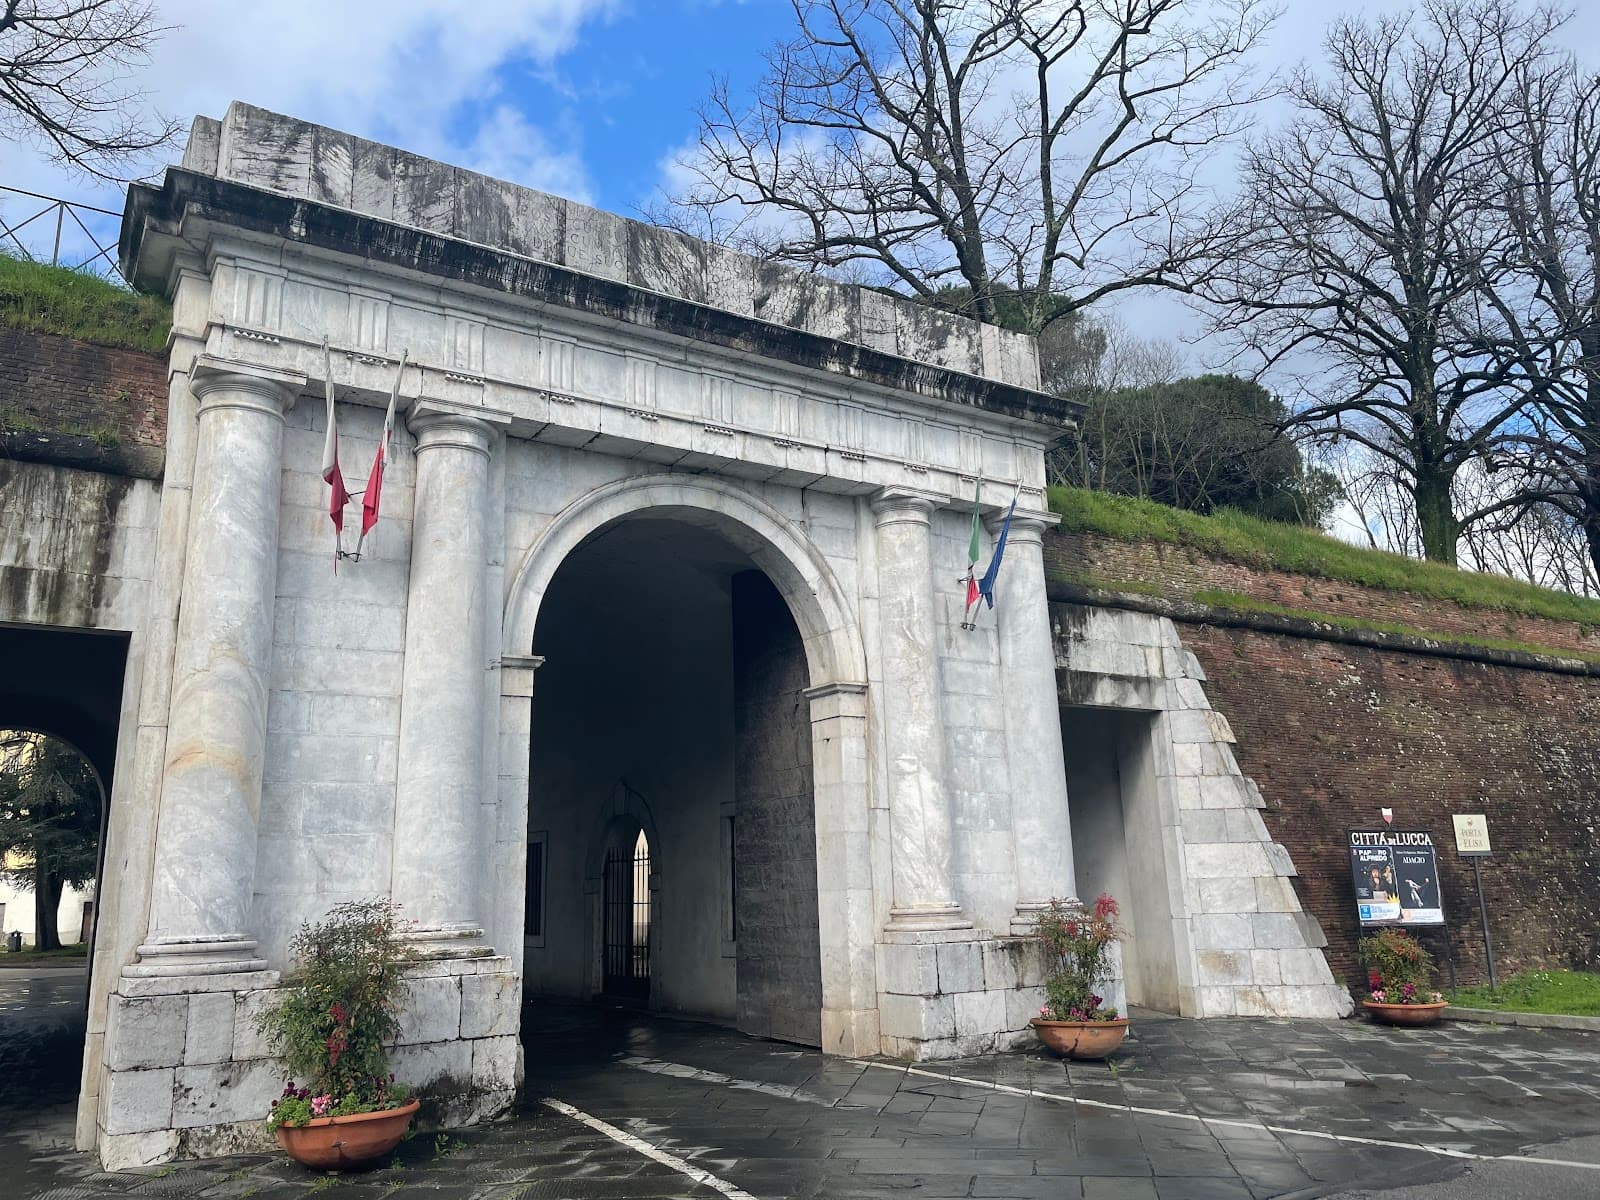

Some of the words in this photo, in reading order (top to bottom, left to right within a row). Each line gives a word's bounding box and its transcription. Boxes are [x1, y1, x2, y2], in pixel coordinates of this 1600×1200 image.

[1461, 829, 1482, 837] PORTA
[1396, 833, 1432, 845] LUCCA
[1463, 839, 1483, 847] ELISA
